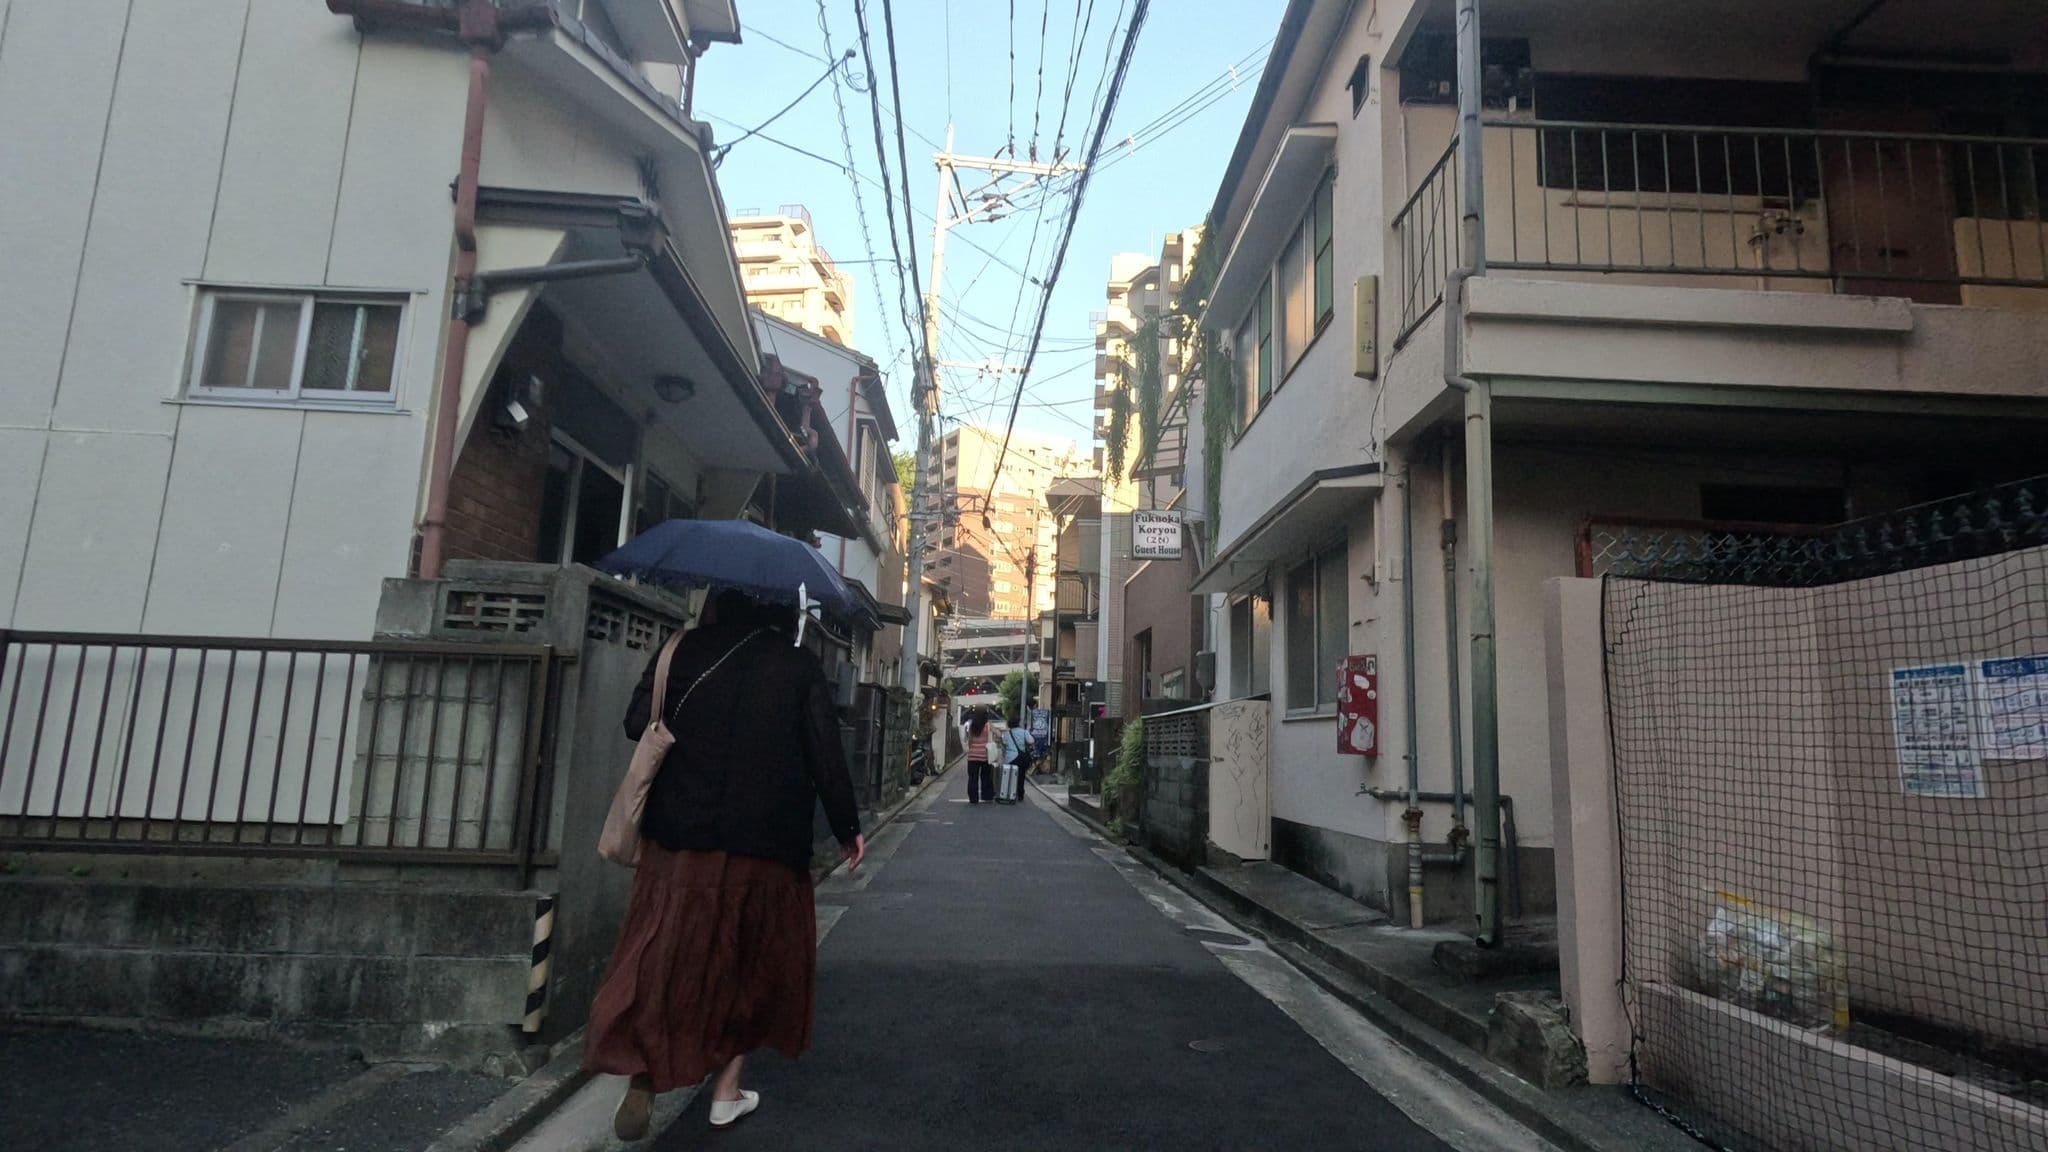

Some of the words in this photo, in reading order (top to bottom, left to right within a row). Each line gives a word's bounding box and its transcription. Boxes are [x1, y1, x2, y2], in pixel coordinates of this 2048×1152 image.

[1135, 513, 1180, 523] Fukuoka
[1138, 525, 1177, 535] Koryou
[1134, 545, 1157, 554] Guest
[1158, 546, 1181, 555] House
